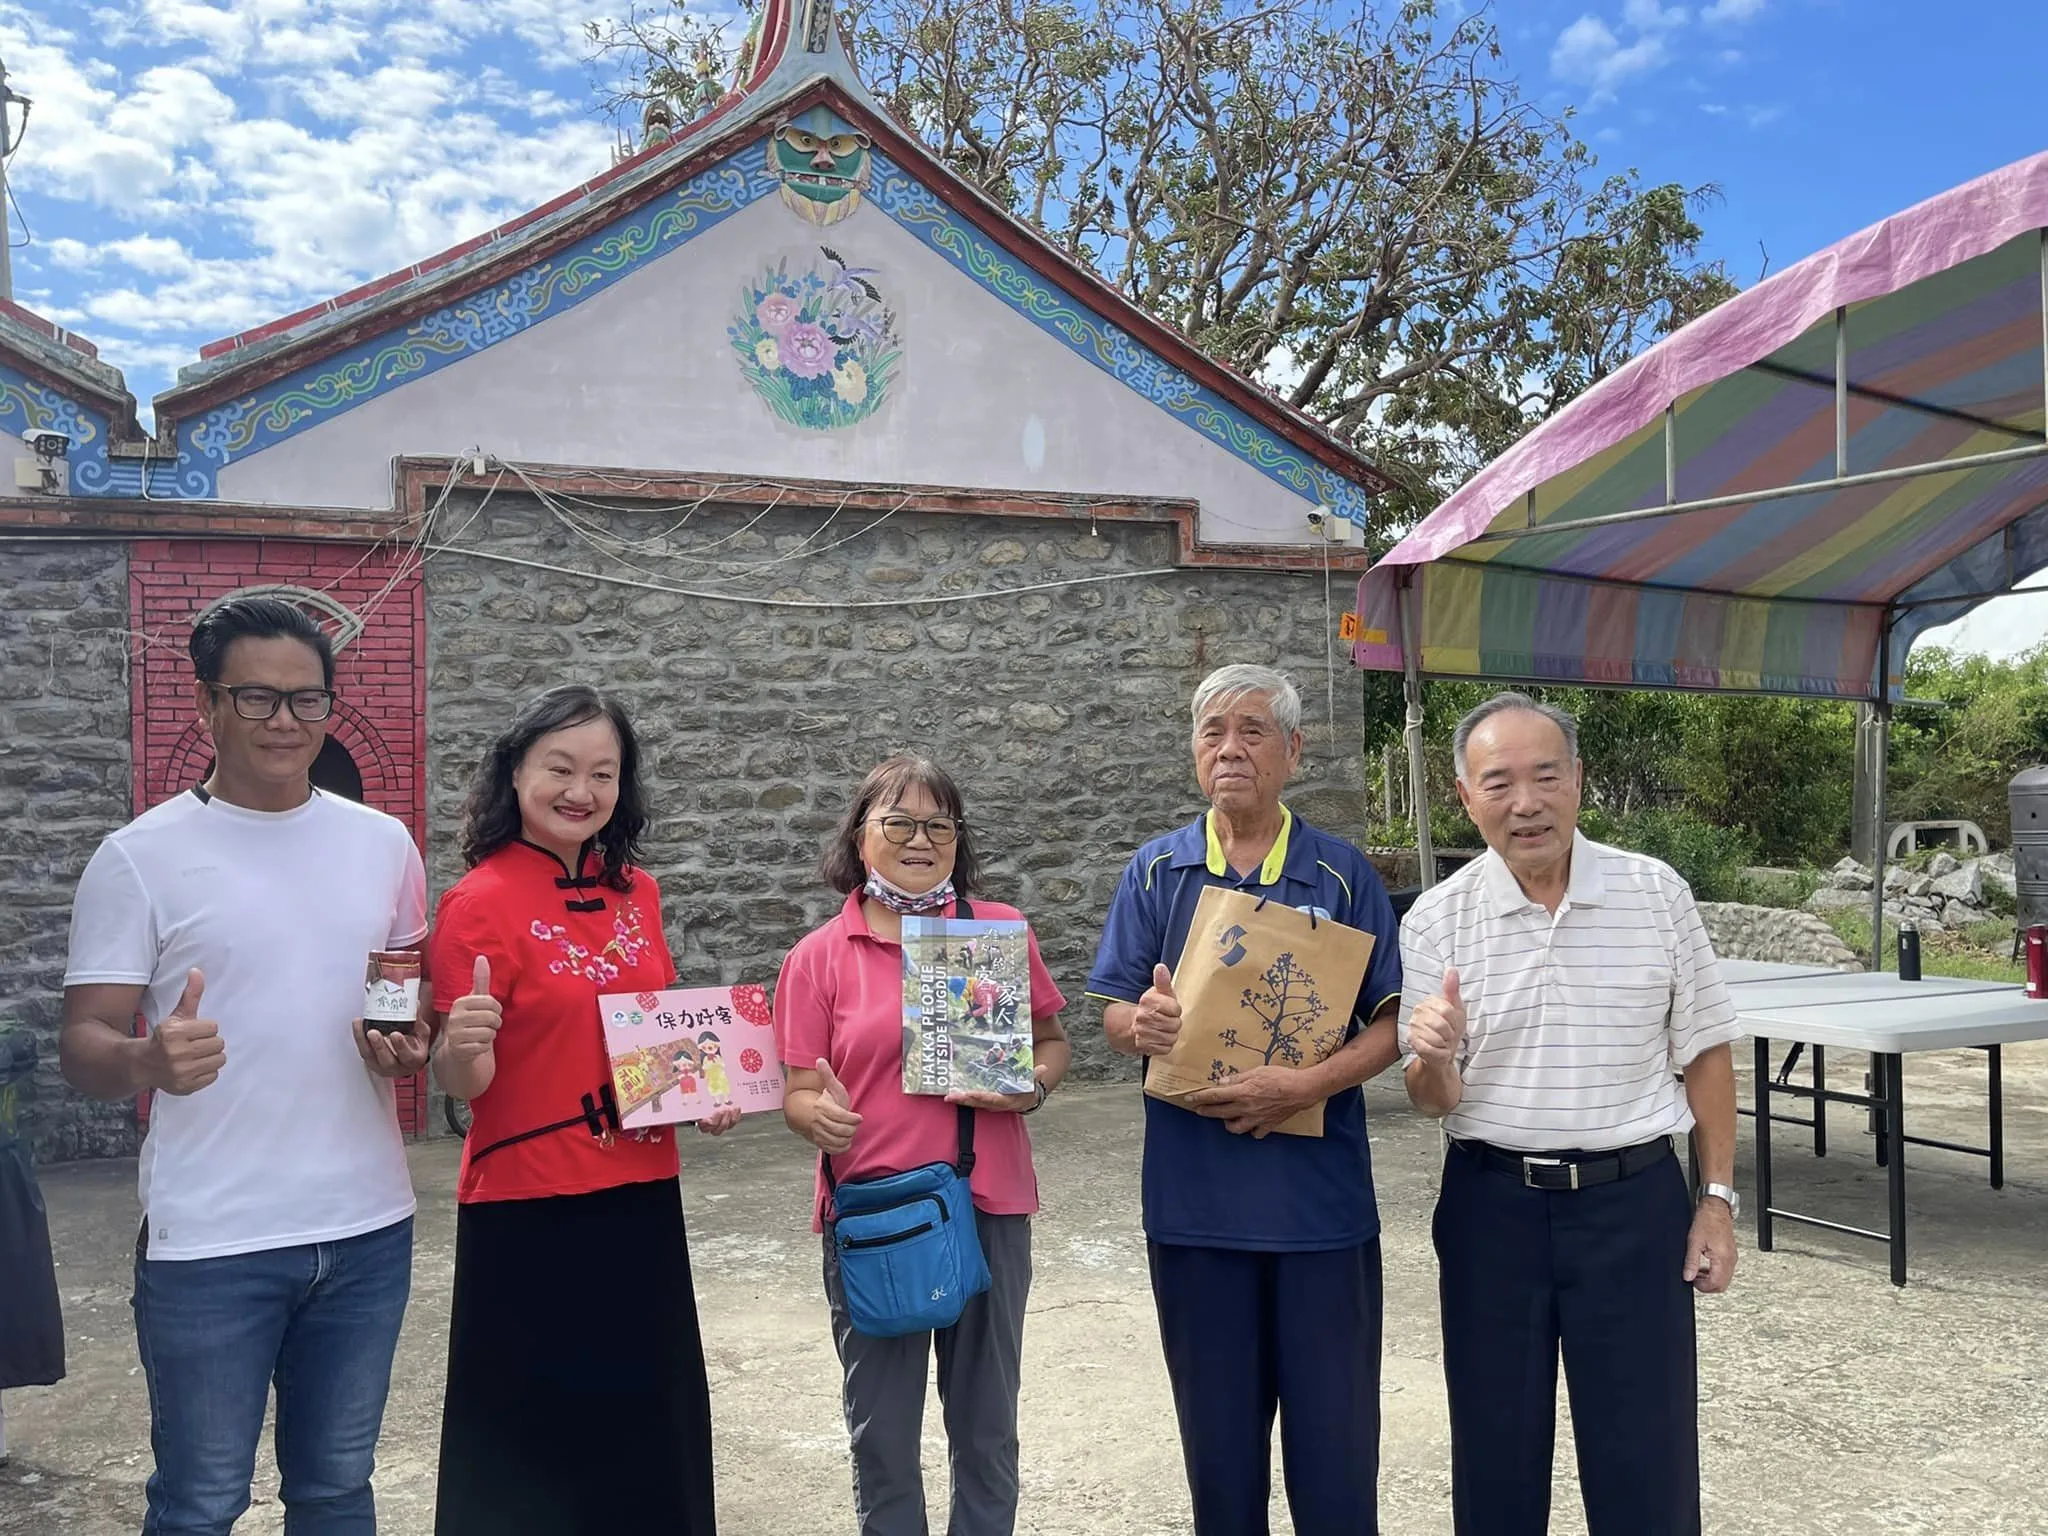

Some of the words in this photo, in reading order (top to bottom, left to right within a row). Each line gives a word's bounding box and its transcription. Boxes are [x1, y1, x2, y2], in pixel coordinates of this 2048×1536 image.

[655, 1005, 733, 1030] 保力好客
[921, 964, 934, 1025] PEOPLE
[935, 965, 947, 1021] LIUGDUI
[922, 1031, 935, 1085] HAKKA
[936, 1025, 948, 1086] OUTSIDE
